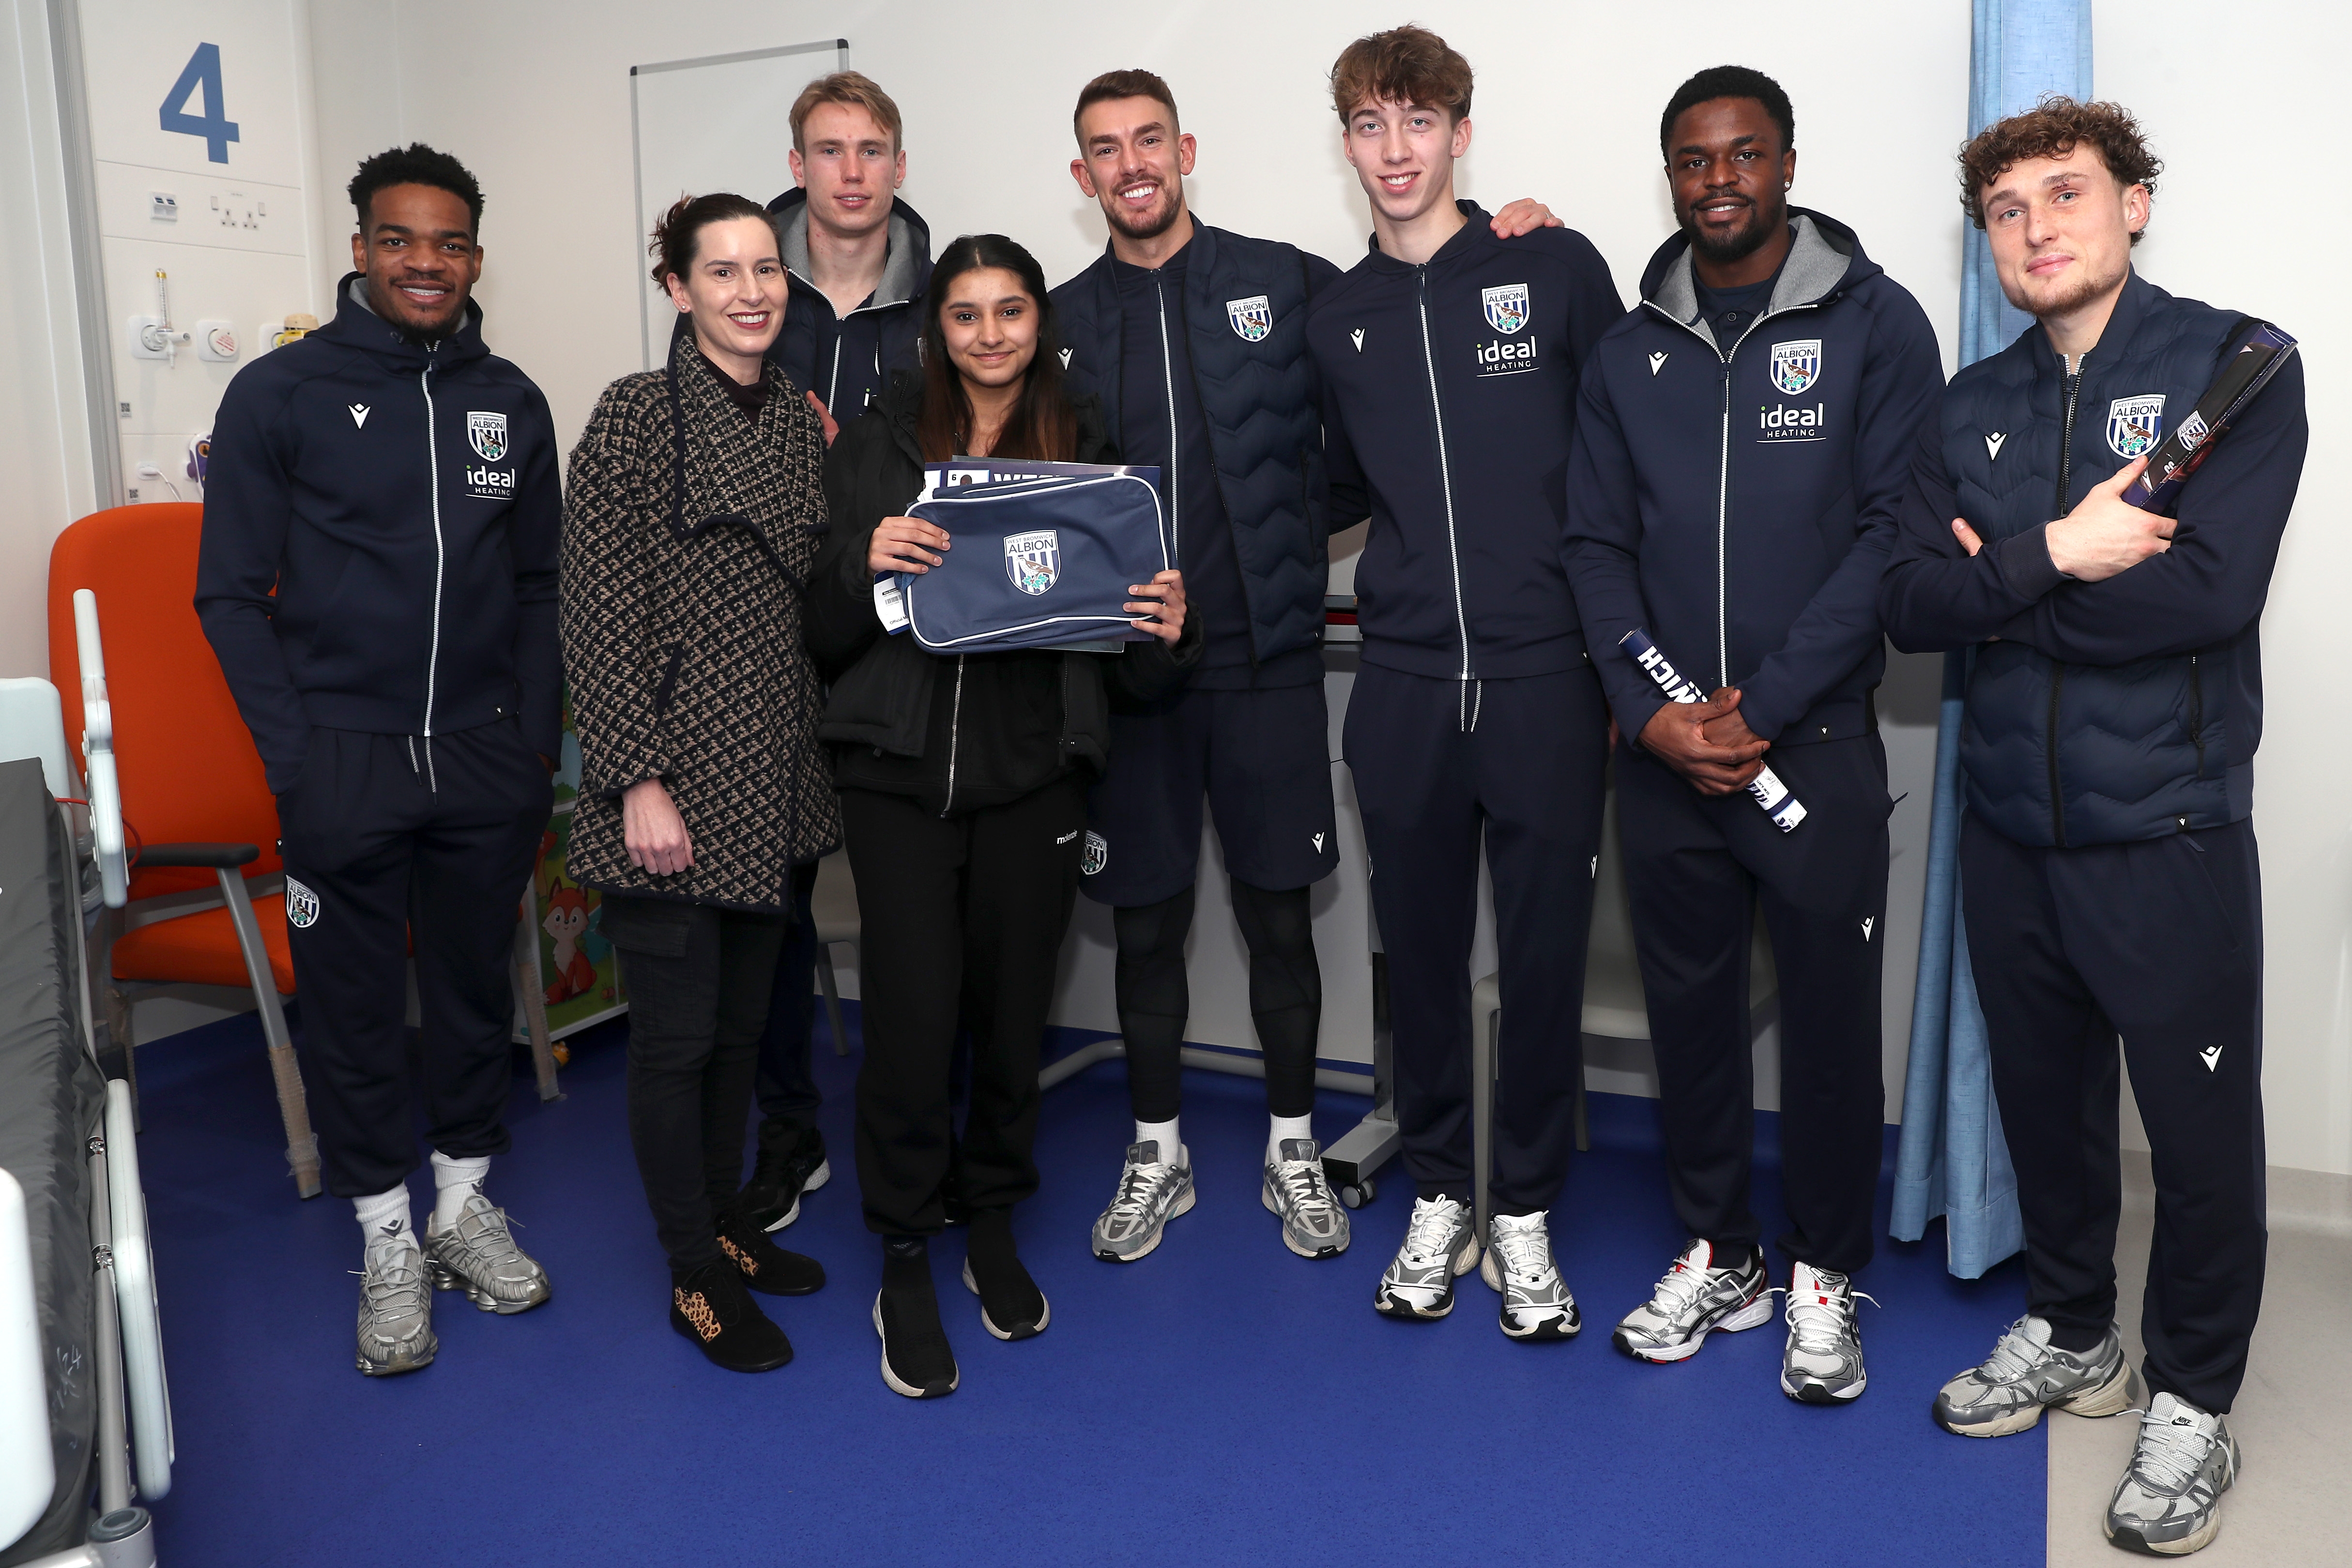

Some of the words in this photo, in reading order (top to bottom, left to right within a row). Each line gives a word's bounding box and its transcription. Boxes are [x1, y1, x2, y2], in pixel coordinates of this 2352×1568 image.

[159, 42, 240, 164] 4
[1488, 292, 1523, 303] ALBION
[1233, 303, 1265, 313] ALBION
[1477, 335, 1536, 364] ideal
[1776, 349, 1815, 359] ALBION
[1486, 361, 1531, 372] HEATING
[1760, 403, 1823, 429] ideal
[2115, 405, 2159, 417] ALBION
[473, 420, 503, 429] ALBION
[2180, 417, 2198, 435] ALBION
[1767, 429, 1816, 438] HEATING
[466, 465, 516, 488] ideal
[475, 487, 511, 496] HEATING
[1023, 533, 1053, 542] BROMWICH
[1008, 538, 1054, 554] ALBION
[889, 616, 903, 624] Official
[290, 885, 315, 901] ALBION
[2176, 1416, 2192, 1425] NIKE
